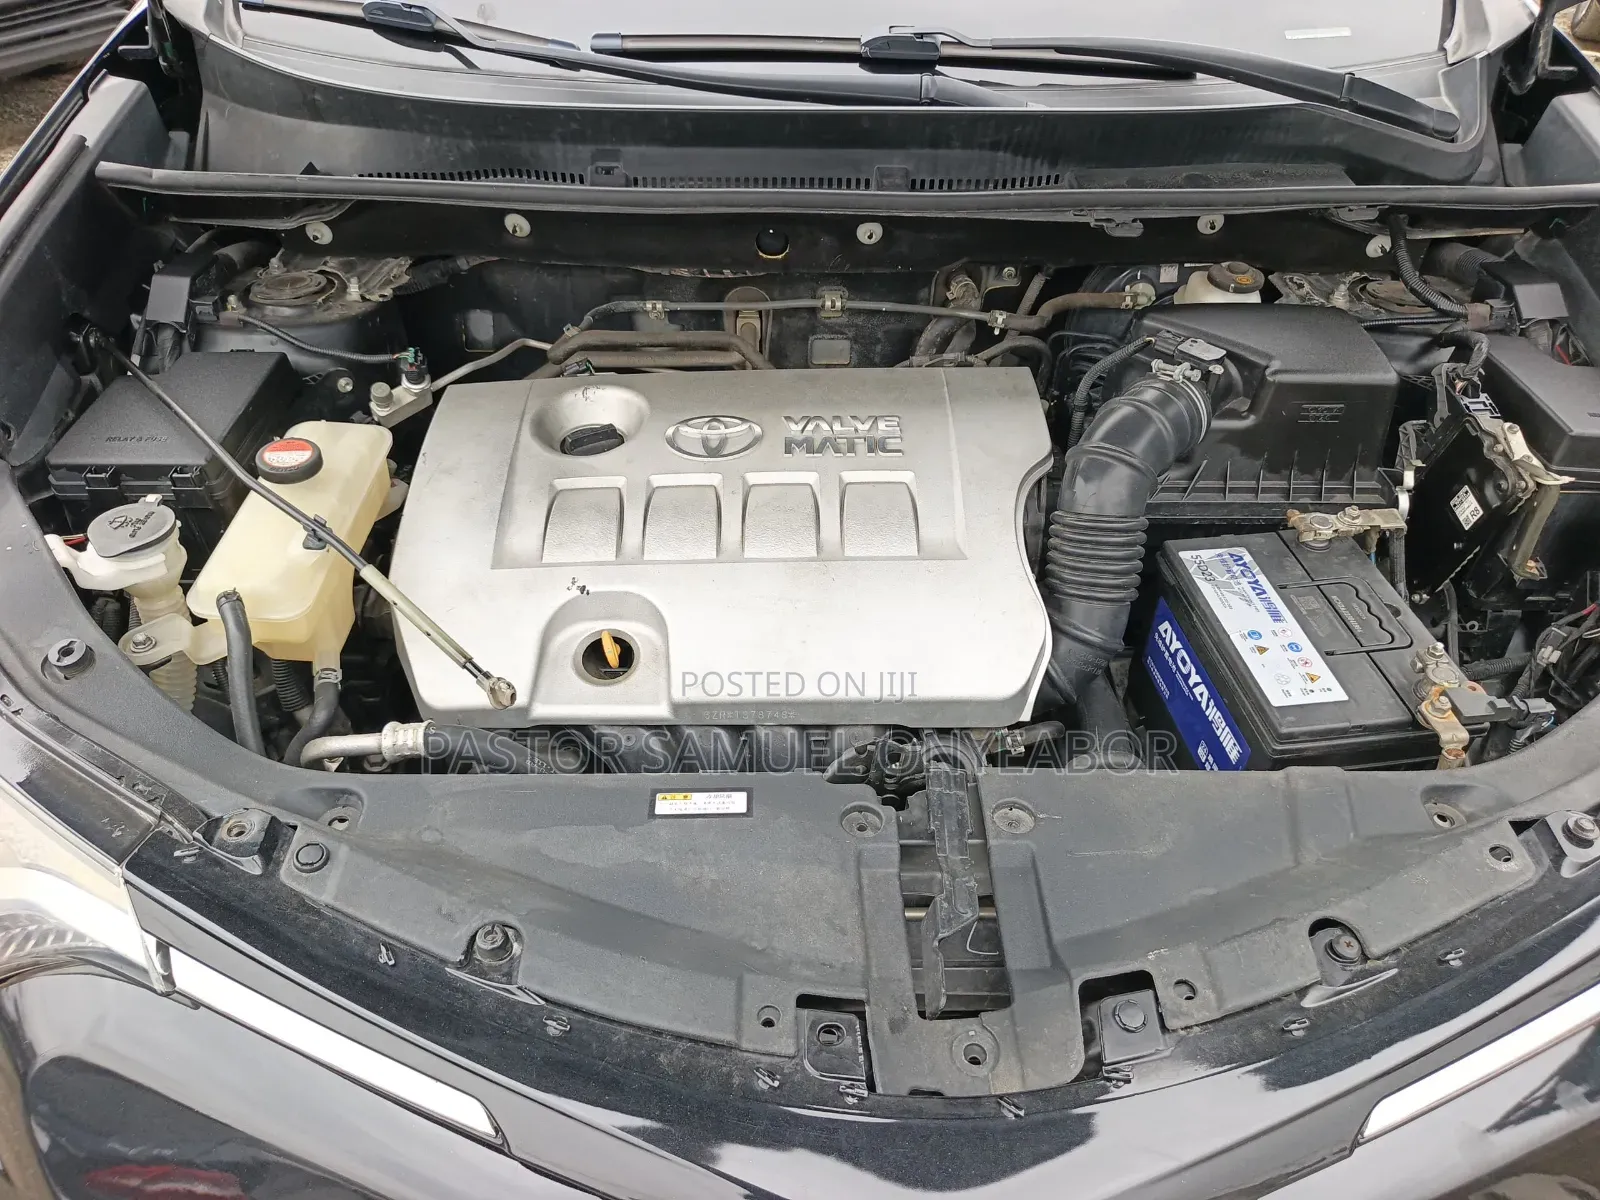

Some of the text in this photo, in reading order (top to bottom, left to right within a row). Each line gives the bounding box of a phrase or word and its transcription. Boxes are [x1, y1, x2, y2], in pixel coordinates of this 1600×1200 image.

[781, 415, 902, 434] VALVE
[783, 435, 904, 456] MATIC
[1469, 506, 1481, 520] R8
[1190, 554, 1216, 582] 55D23
[1228, 552, 1268, 597] AYOYA
[1157, 620, 1211, 712] AYOYA
